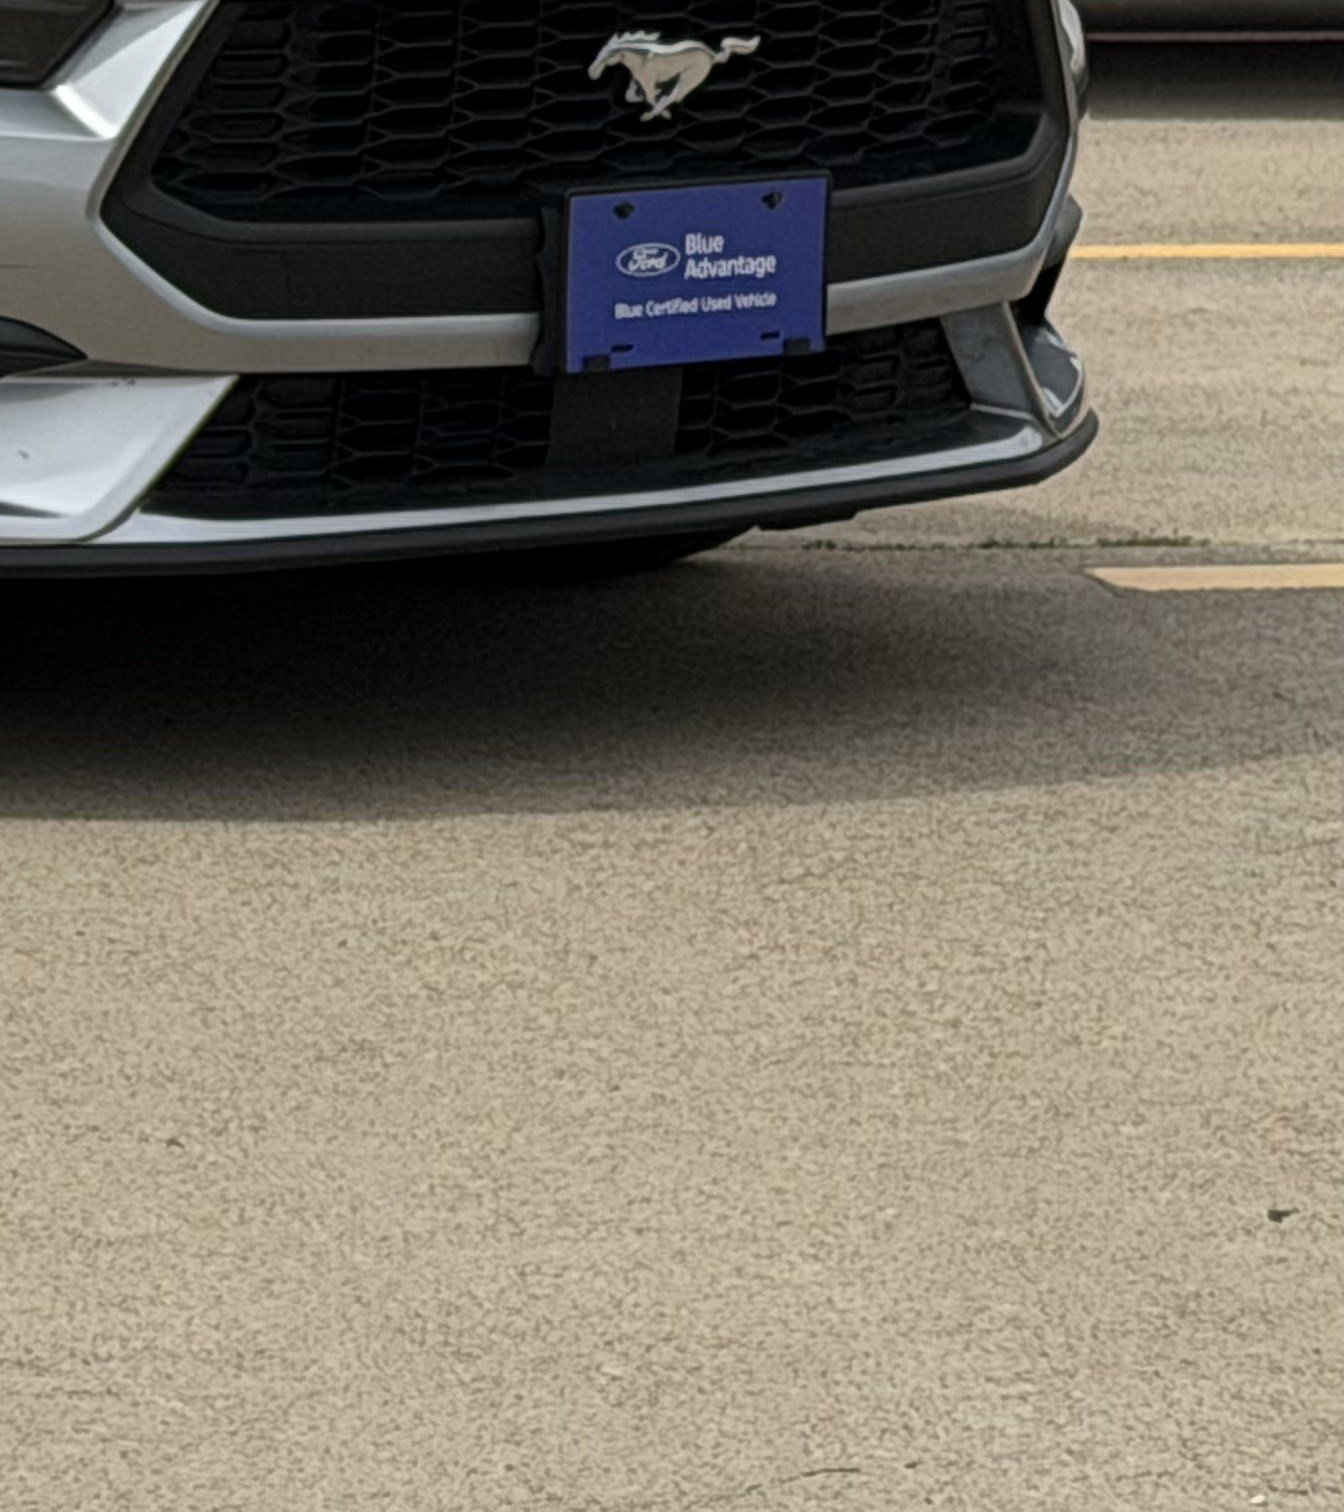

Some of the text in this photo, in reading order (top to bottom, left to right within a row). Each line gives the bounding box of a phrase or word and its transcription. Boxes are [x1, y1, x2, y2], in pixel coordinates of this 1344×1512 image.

[684, 232, 725, 255] Blue
[684, 255, 778, 280] Advantage
[614, 291, 778, 320] Blue Certified Used Vehicle
